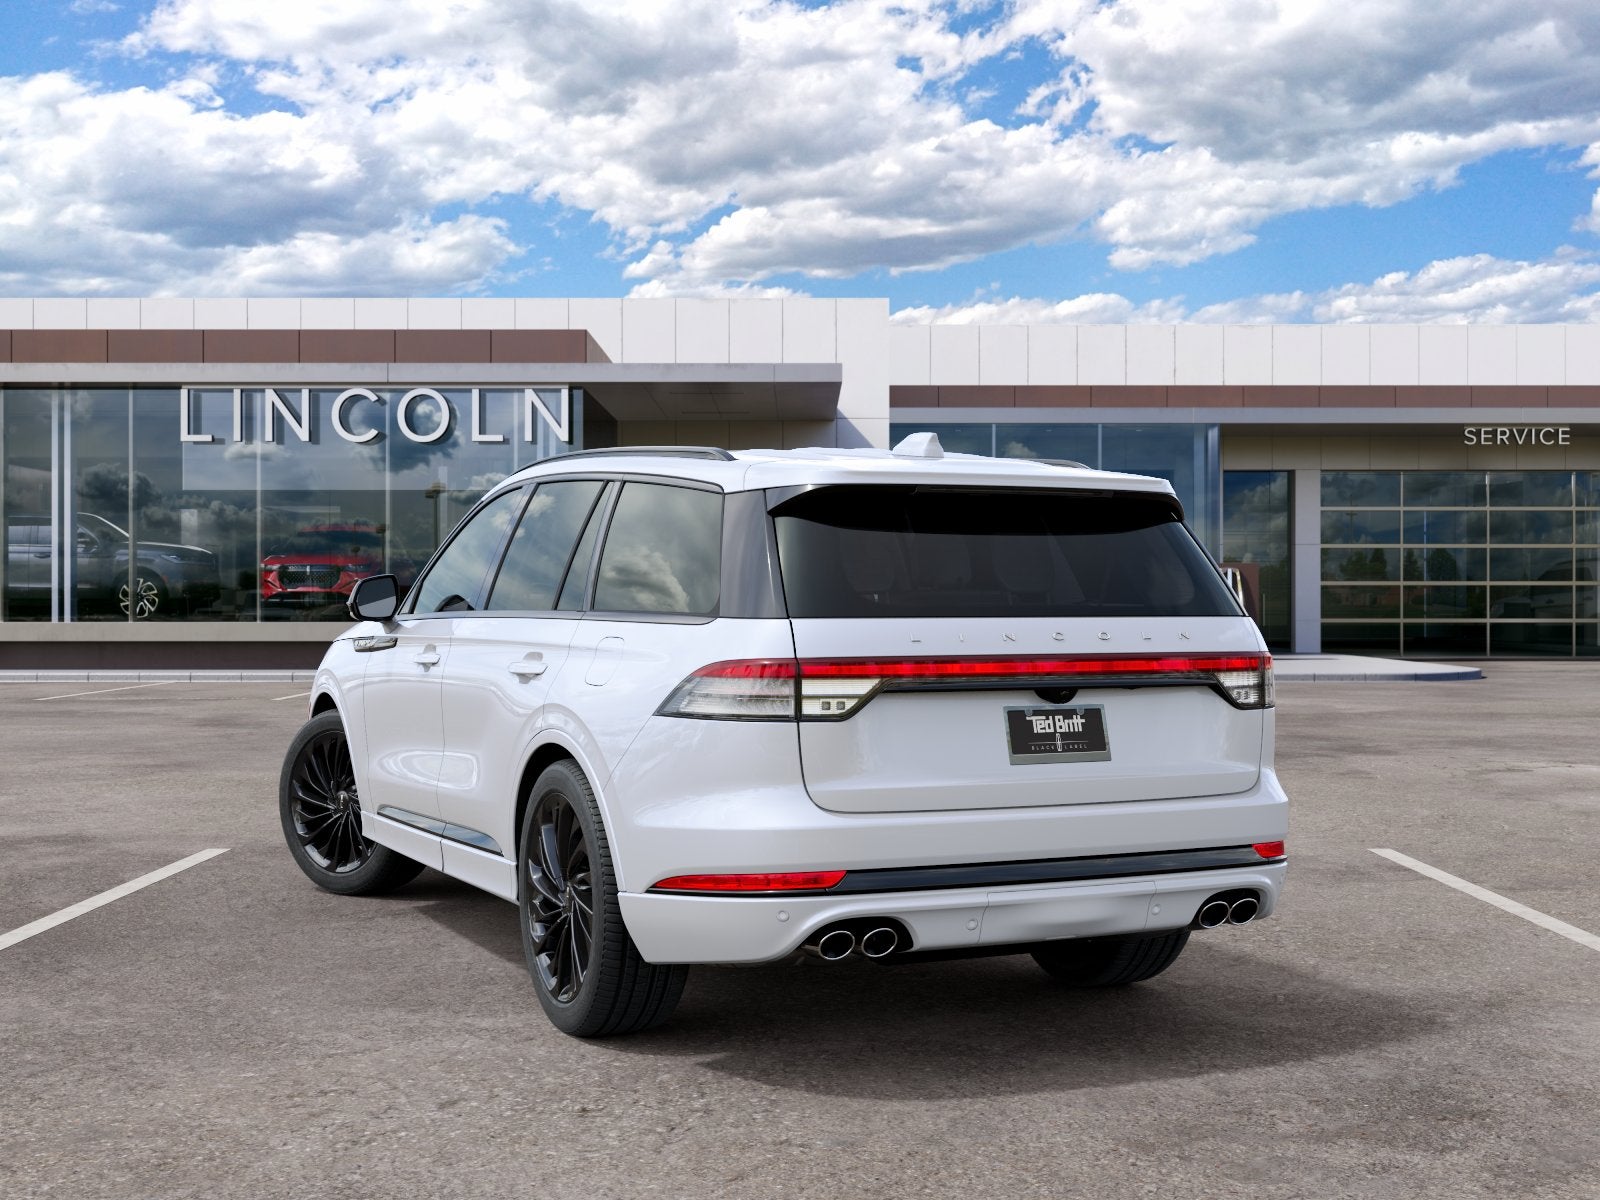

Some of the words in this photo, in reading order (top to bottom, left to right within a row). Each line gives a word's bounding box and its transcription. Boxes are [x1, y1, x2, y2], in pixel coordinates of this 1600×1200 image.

[180, 387, 570, 443] LINCOLN
[1463, 427, 1571, 446] SERVICE
[909, 631, 1193, 643] LINCOLN
[1026, 716, 1054, 734] Ted
[1055, 715, 1086, 733] Britt
